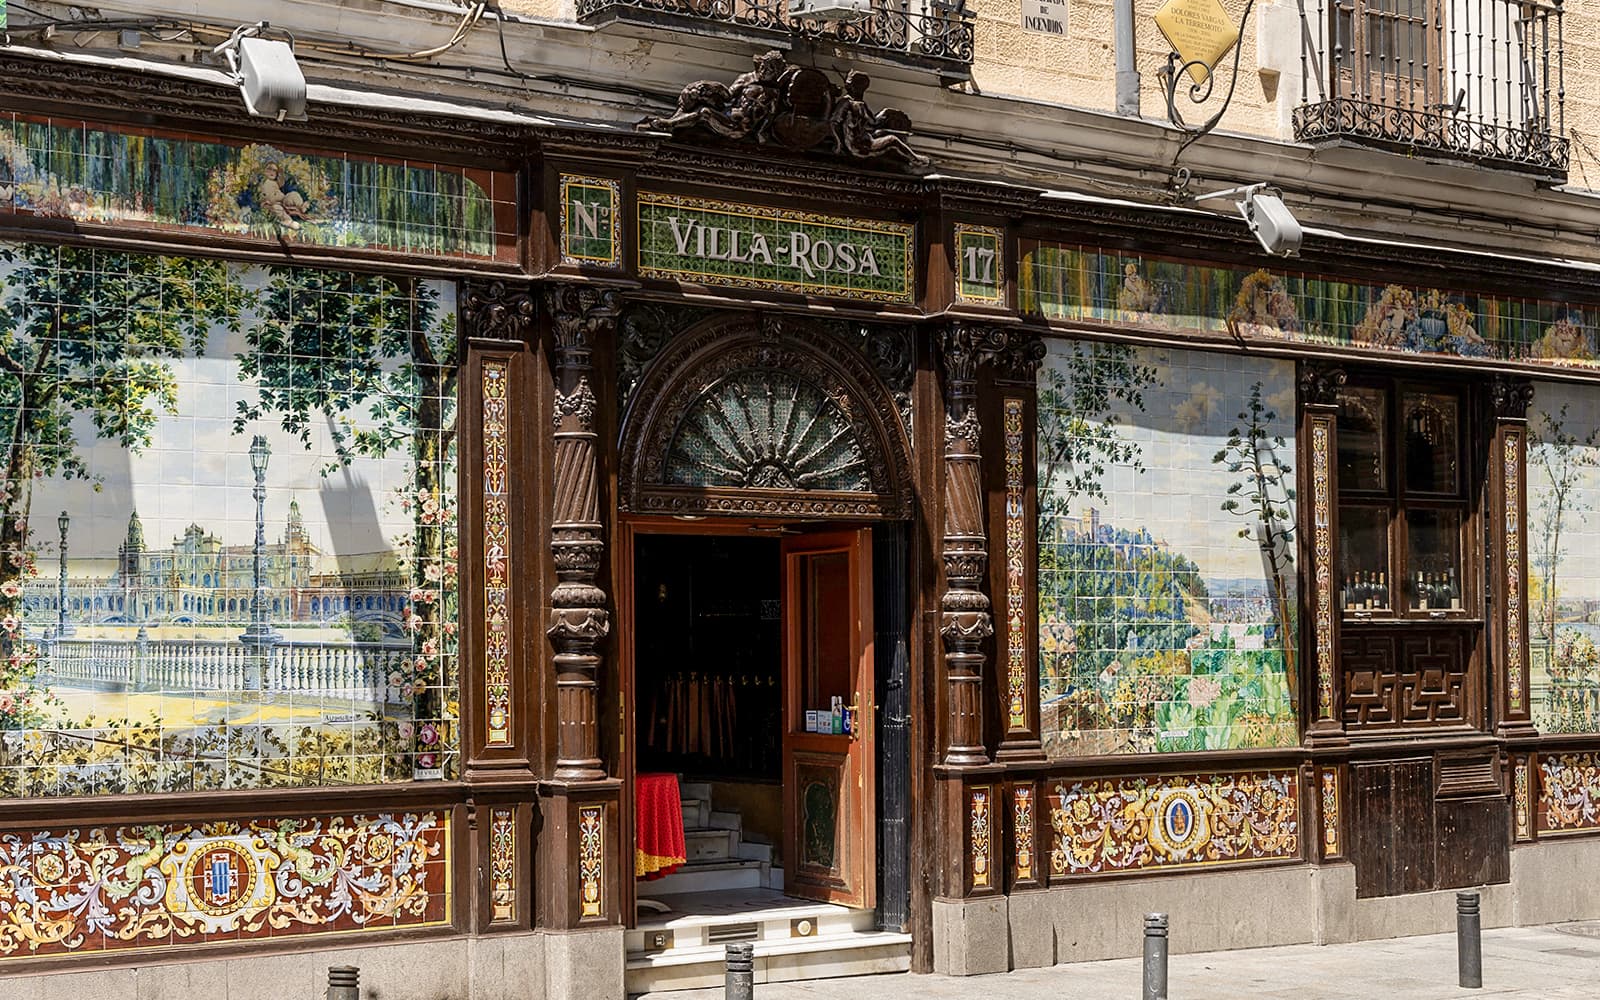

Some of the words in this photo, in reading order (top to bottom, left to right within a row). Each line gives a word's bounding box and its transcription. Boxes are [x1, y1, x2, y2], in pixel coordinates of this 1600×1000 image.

[1040, 5, 1049, 14] DE
[1171, 7, 1200, 19] DOLORES
[1201, 13, 1225, 26] VARGAS
[1025, 15, 1063, 34] INCENDIOS
[668, 216, 882, 279] VILLA-ROSA
[963, 246, 995, 284] 17
